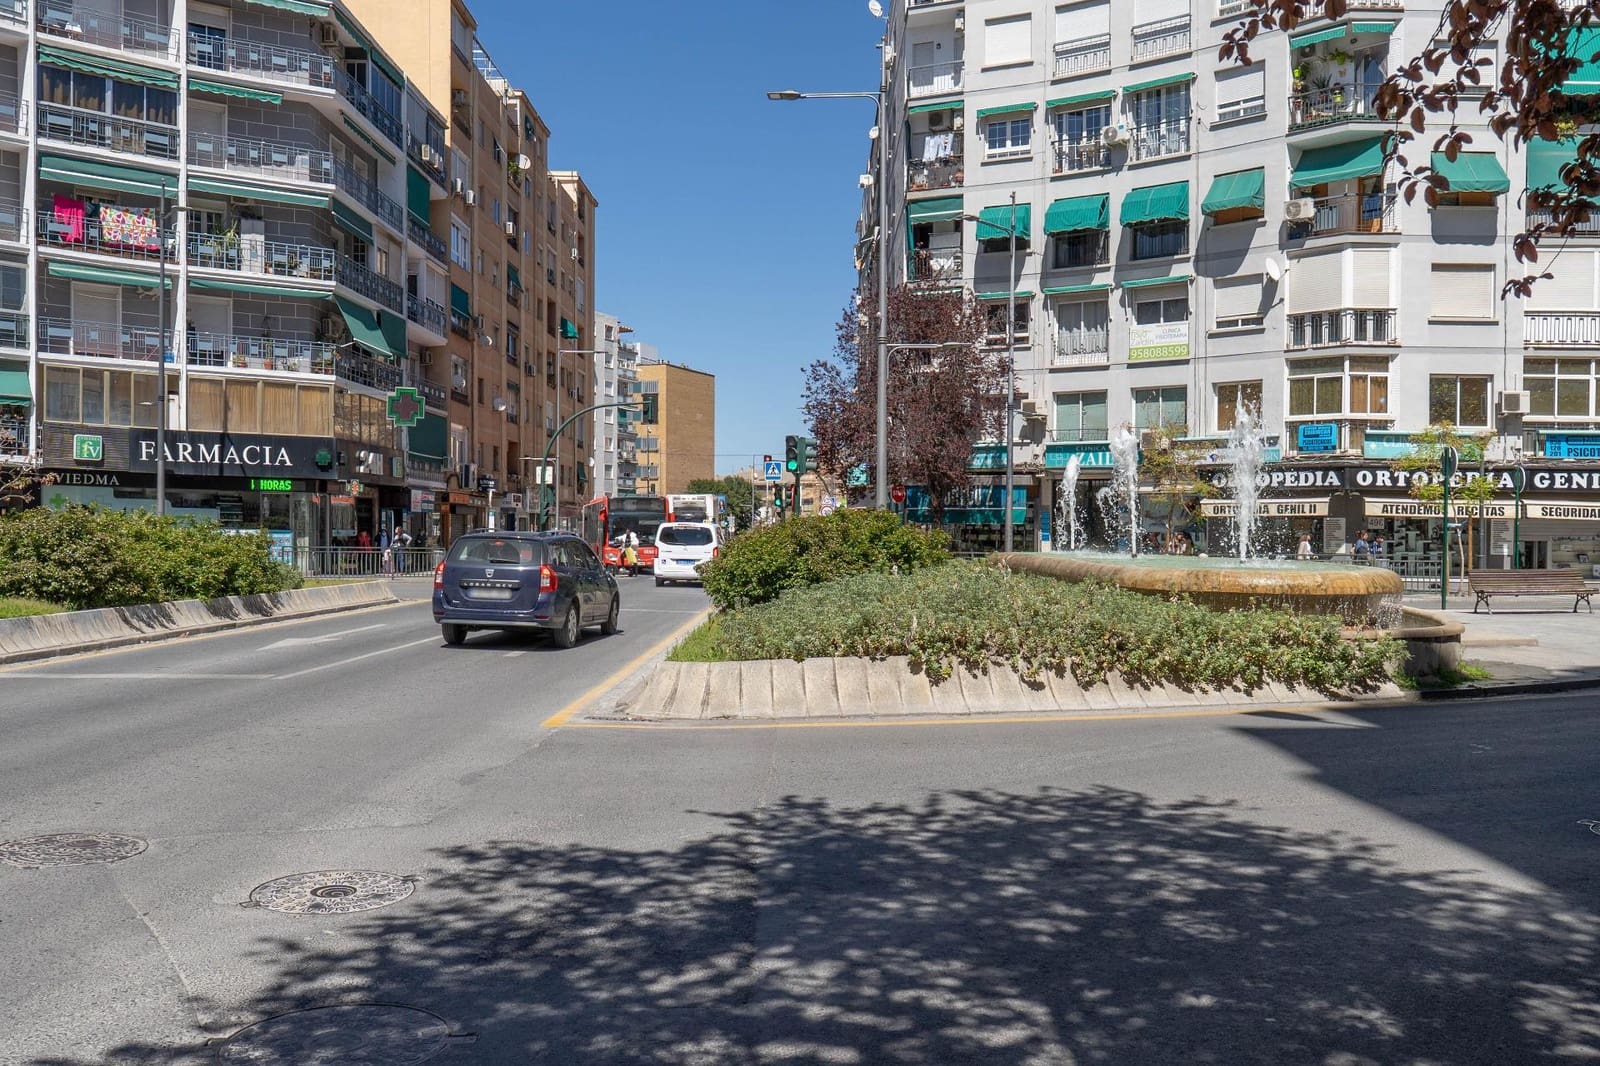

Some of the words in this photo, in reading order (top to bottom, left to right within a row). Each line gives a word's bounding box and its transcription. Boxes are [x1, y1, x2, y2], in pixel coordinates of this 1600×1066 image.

[1130, 345, 1188, 359] 958088599
[138, 440, 294, 467] FARMACIA
[260, 479, 292, 490] HORAS
[1381, 504, 1446, 516] ATENDEMO
[1457, 505, 1505, 517] RECTAS
